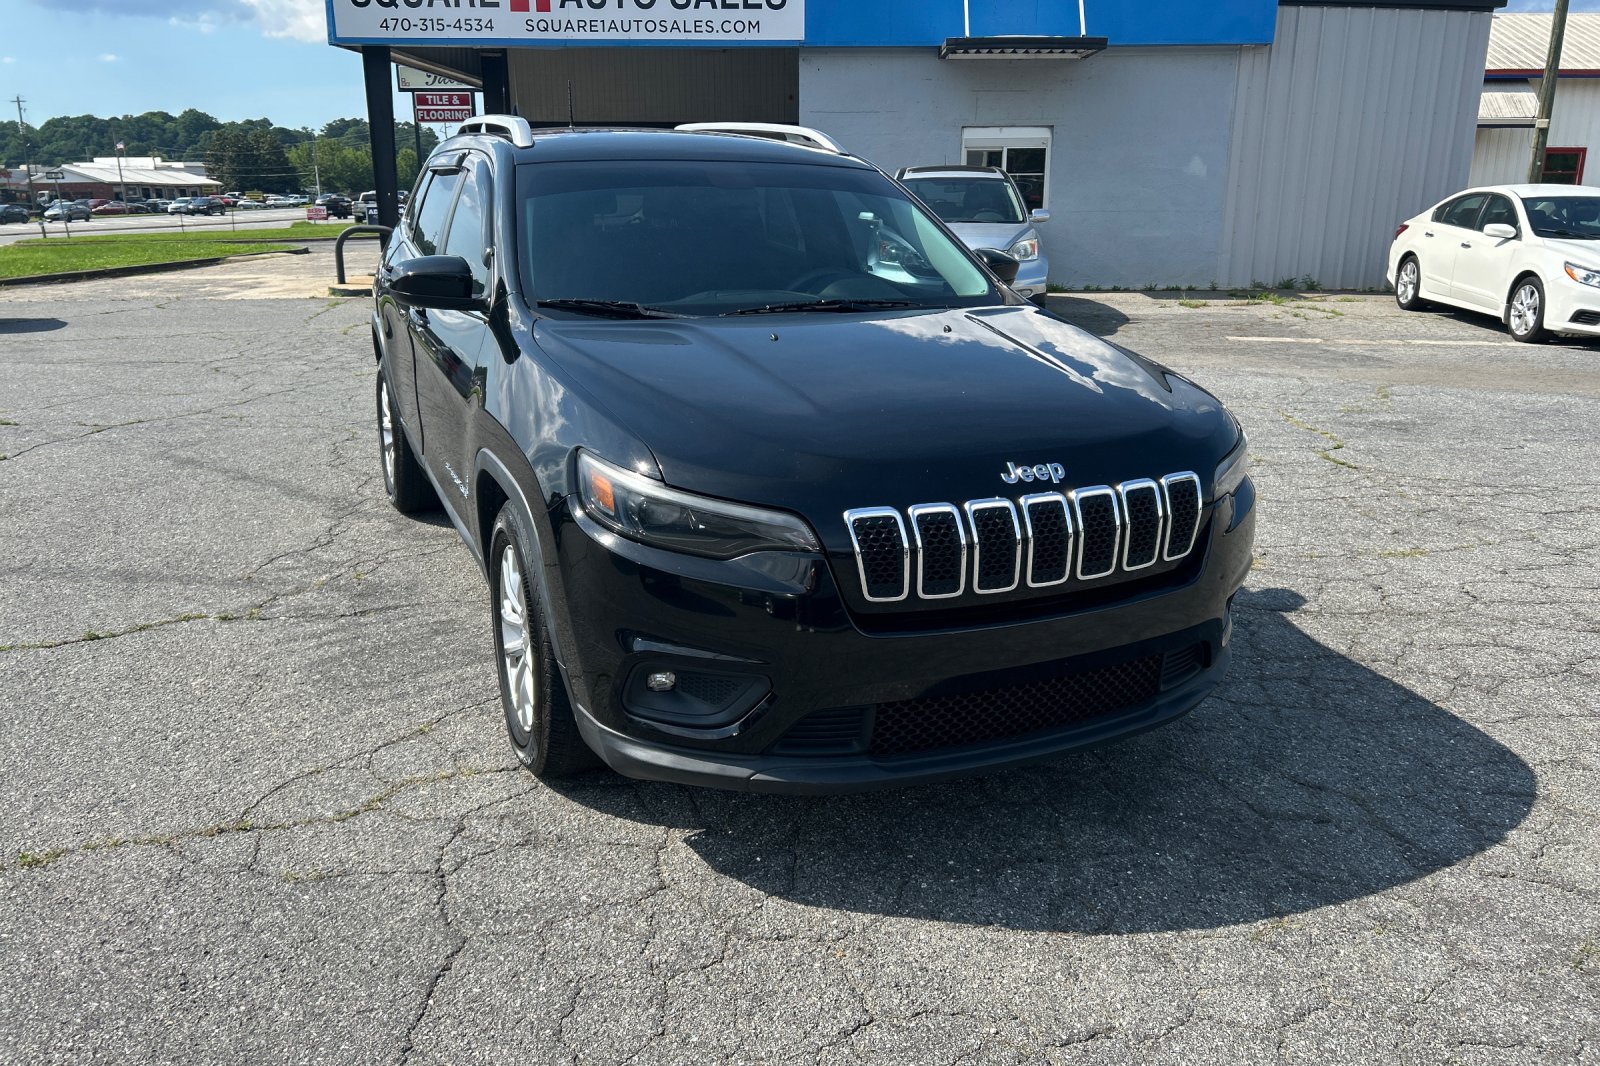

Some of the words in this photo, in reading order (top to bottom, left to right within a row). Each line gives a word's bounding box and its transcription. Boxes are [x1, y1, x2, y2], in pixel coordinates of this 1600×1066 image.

[379, 18, 495, 32] 470-315-4534
[525, 18, 761, 33] SQUARE1AUTOSALES.COM
[426, 95, 449, 105] TILE
[452, 95, 460, 105] &
[418, 110, 470, 120] FLOORING
[1001, 462, 1065, 484] Jeep
